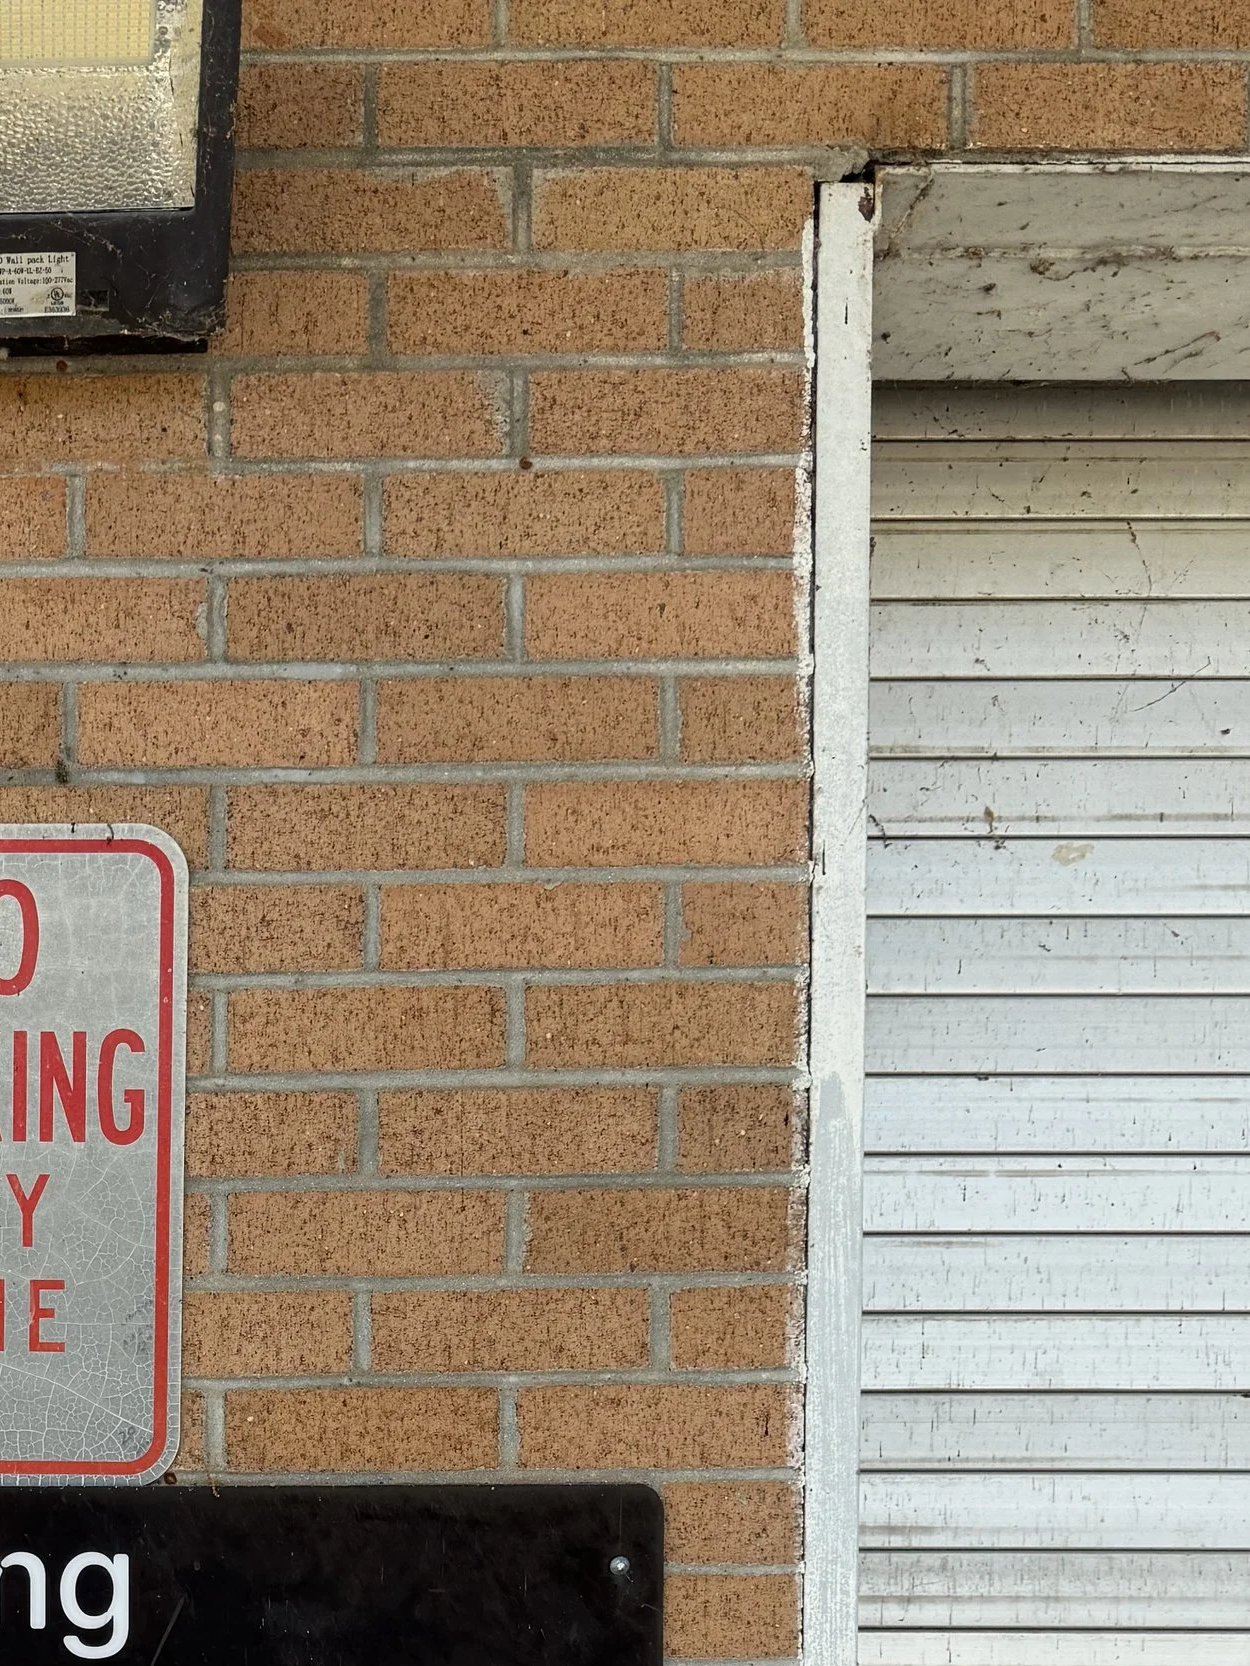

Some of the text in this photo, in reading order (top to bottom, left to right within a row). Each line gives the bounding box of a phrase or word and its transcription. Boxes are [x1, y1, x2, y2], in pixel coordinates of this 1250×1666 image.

[6, 256, 23, 264] Wall
[27, 255, 44, 265] pack
[48, 254, 70, 264] Light
